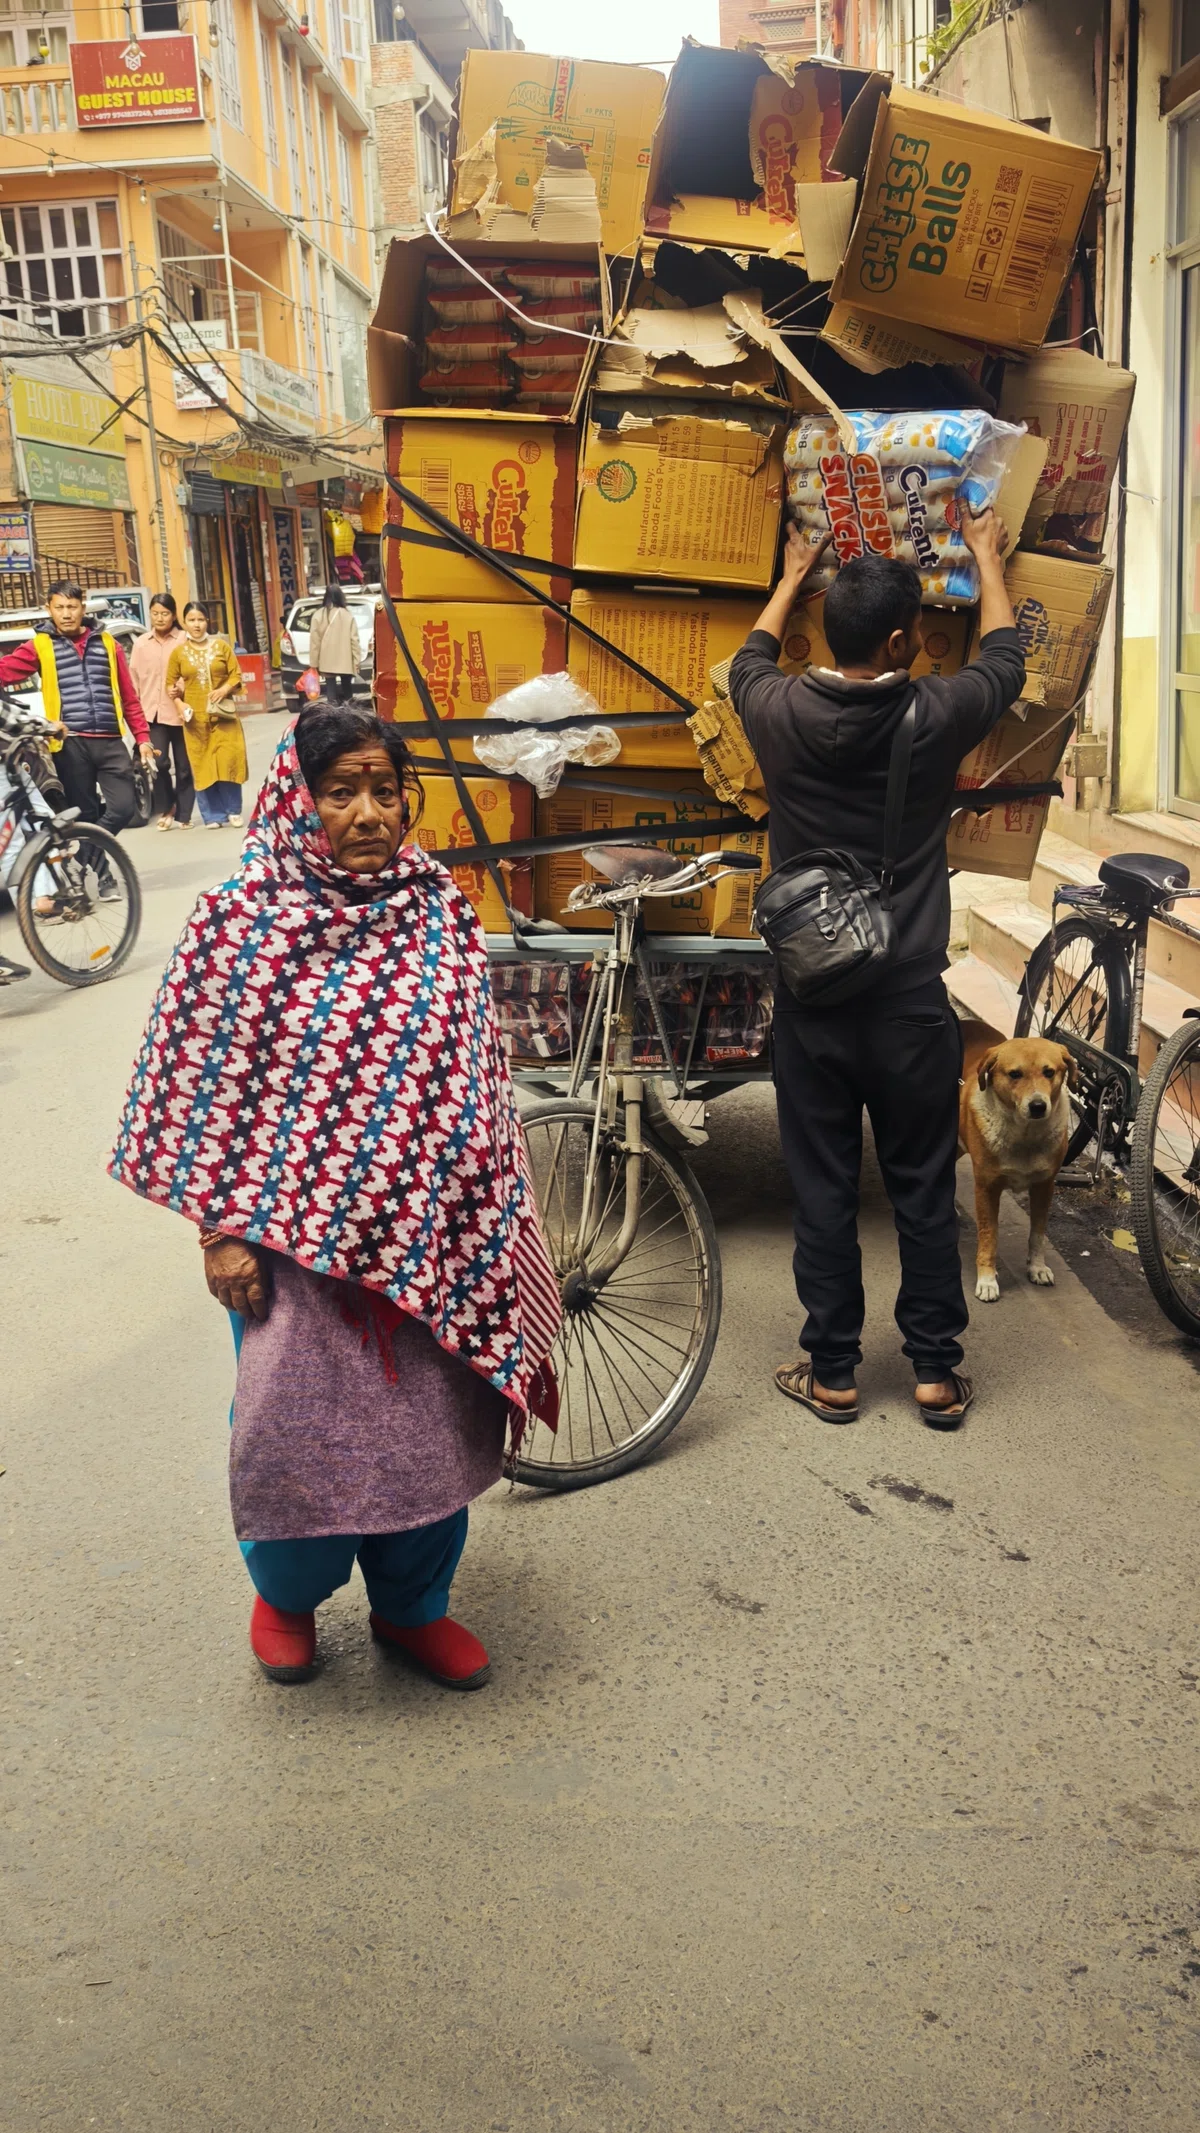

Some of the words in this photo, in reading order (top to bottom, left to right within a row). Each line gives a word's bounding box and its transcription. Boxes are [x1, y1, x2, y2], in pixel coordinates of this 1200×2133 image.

[78, 92, 134, 110] GUEST
[137, 87, 196, 106] HOUSE
[105, 72, 164, 89] MACAU
[552, 59, 571, 123] CENTURY
[859, 133, 930, 293] CHEESE
[907, 160, 972, 276] Balls
[956, 230, 967, 254] TASTY
[966, 188, 979, 226] DELICIOUS
[970, 217, 979, 231] AND
[974, 202, 983, 218] BITE
[24, 381, 79, 428] HOTEL
[673, 427, 679, 435] 15
[684, 426, 691, 435] 59
[1062, 438, 1071, 461] MASALA
[492, 459, 526, 553] Curren
[654, 478, 664, 509] Foods
[674, 493, 685, 515] Nepal,
[638, 487, 652, 556] Manufactured
[646, 468, 655, 483] by:
[899, 464, 942, 569] Current
[670, 518, 683, 558] Rupandehi,
[667, 611, 676, 650] Rupandehi,
[690, 613, 698, 654] Yashoda
[699, 612, 708, 679] Manufactured
[1034, 618, 1051, 645] MIX
[471, 633, 484, 669] Sticks
[666, 653, 674, 674] Nepal,
[675, 646, 685, 690] Municipality,
[687, 657, 695, 688] Foods
[697, 682, 705, 697] by:
[663, 728, 670, 737] 59
[705, 749, 732, 792] VENTILATED
